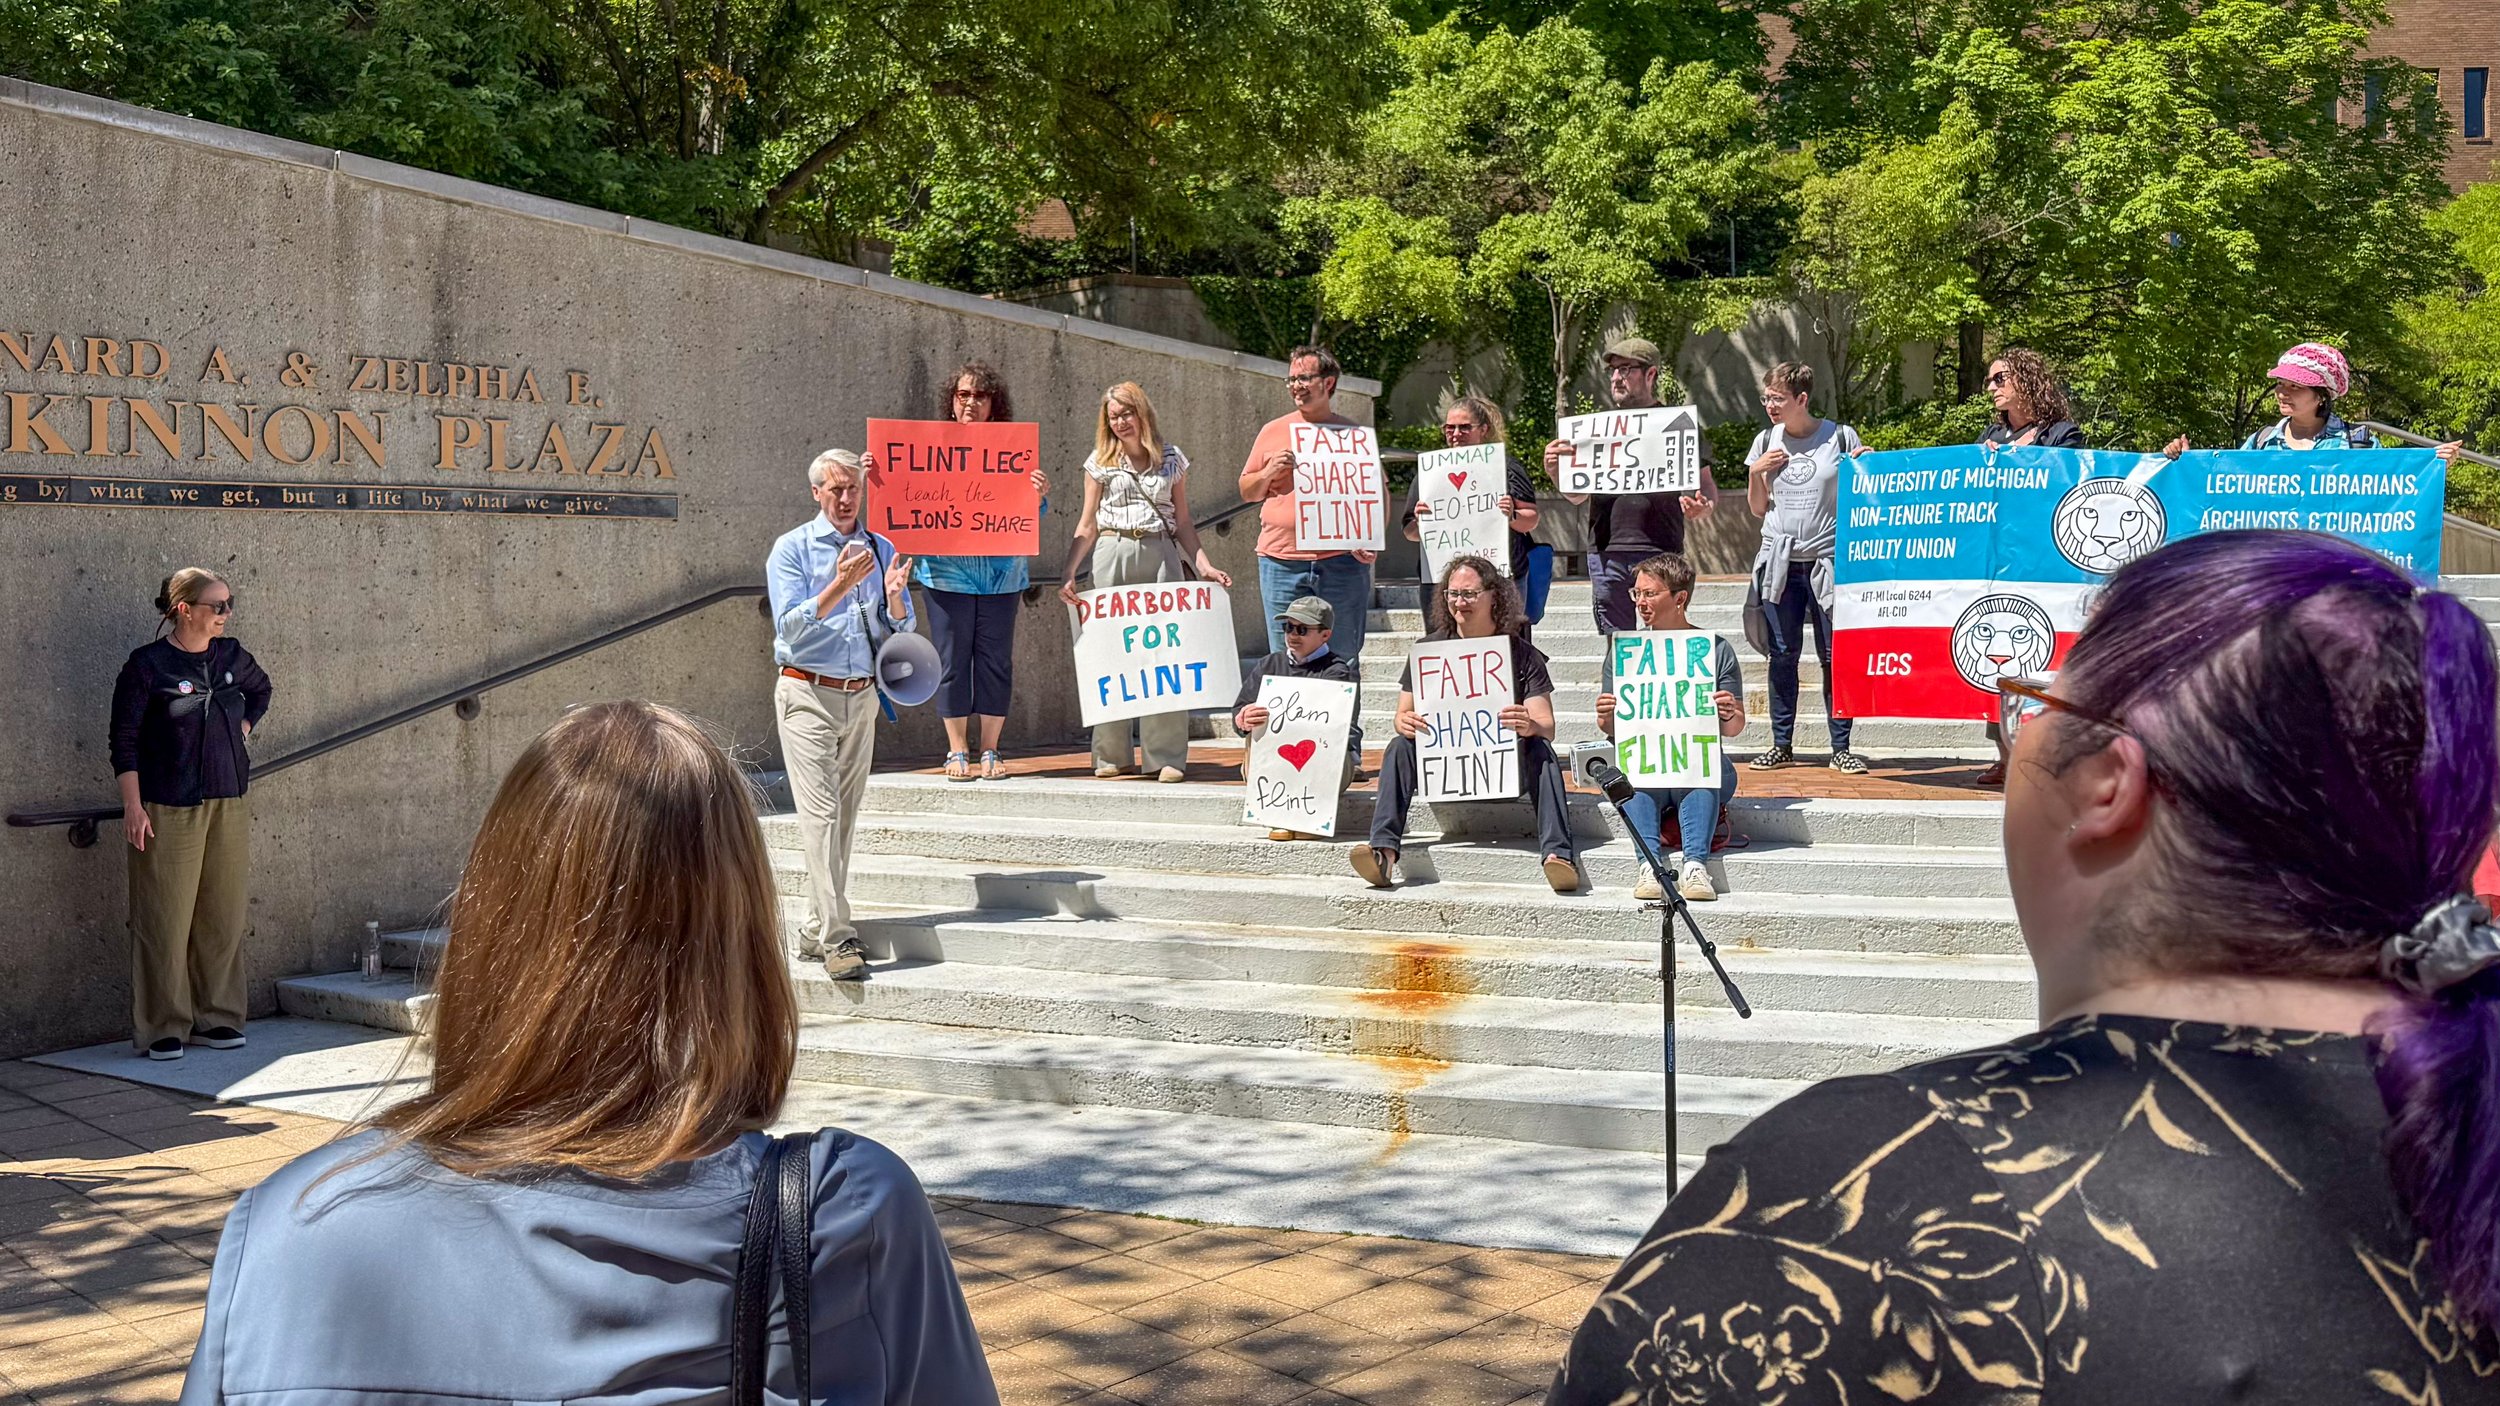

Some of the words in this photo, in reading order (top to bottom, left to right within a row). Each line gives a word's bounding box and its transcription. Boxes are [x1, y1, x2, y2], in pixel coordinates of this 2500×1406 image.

[200, 346, 250, 385] A.
[280, 352, 319, 389] &
[348, 355, 544, 404] ZELPHA
[566, 370, 603, 408] E.
[3, 391, 390, 469] KINNON
[433, 413, 677, 479] PLAZA
[1295, 426, 1371, 455] FAIR
[1571, 413, 1649, 439] FLINT
[887, 442, 972, 473] FLINT
[1421, 445, 1495, 472] UMMAP
[1571, 437, 1641, 469] LECS
[1665, 436, 1676, 484] MORE
[1686, 435, 1695, 484] MORE
[905, 481, 955, 502] teach
[965, 480, 996, 502] the
[1297, 461, 1376, 495] SHARE
[1572, 468, 1666, 491] DESERVE
[1852, 469, 1938, 494] UNIVERSITY
[1940, 468, 1960, 490] OF
[1963, 466, 2050, 490] MICHIGAN
[2205, 473, 2305, 497] LECTURERS,
[2310, 473, 2419, 496] LIBRARIANS,
[38, 479, 67, 502] by
[89, 483, 145, 500] what
[170, 488, 199, 501] we
[222, 490, 260, 506] get,
[282, 488, 315, 504] but
[337, 494, 348, 506] a
[368, 490, 402, 507] life
[421, 491, 444, 511] by
[462, 494, 508, 510] what
[525, 497, 550, 511] we
[970, 512, 1034, 533] SHARE
[1299, 500, 1379, 540] FLINT
[1850, 503, 1944, 528] NON-TENURE
[1948, 501, 1999, 524] TRACK
[2308, 511, 2320, 531] &
[2325, 509, 2416, 533] CURATORS
[1423, 527, 1474, 550] FAIR
[1848, 538, 1902, 562] FACULTY
[1905, 537, 1957, 560] UNION
[1078, 586, 1211, 625] DEARBORN
[1886, 589, 1907, 602] Local
[1908, 590, 1932, 601] 6244
[1877, 605, 1908, 618] AFL-CIO
[1122, 622, 1181, 654] FOR
[1614, 636, 1714, 678] FAIR
[1866, 652, 1913, 676] LECS
[1097, 661, 1208, 707] FLINT
[1418, 650, 1508, 700] FAIR
[1616, 679, 1716, 721] SHARE
[1617, 732, 1718, 777] FLINT
[1422, 748, 1515, 797] FLINT
